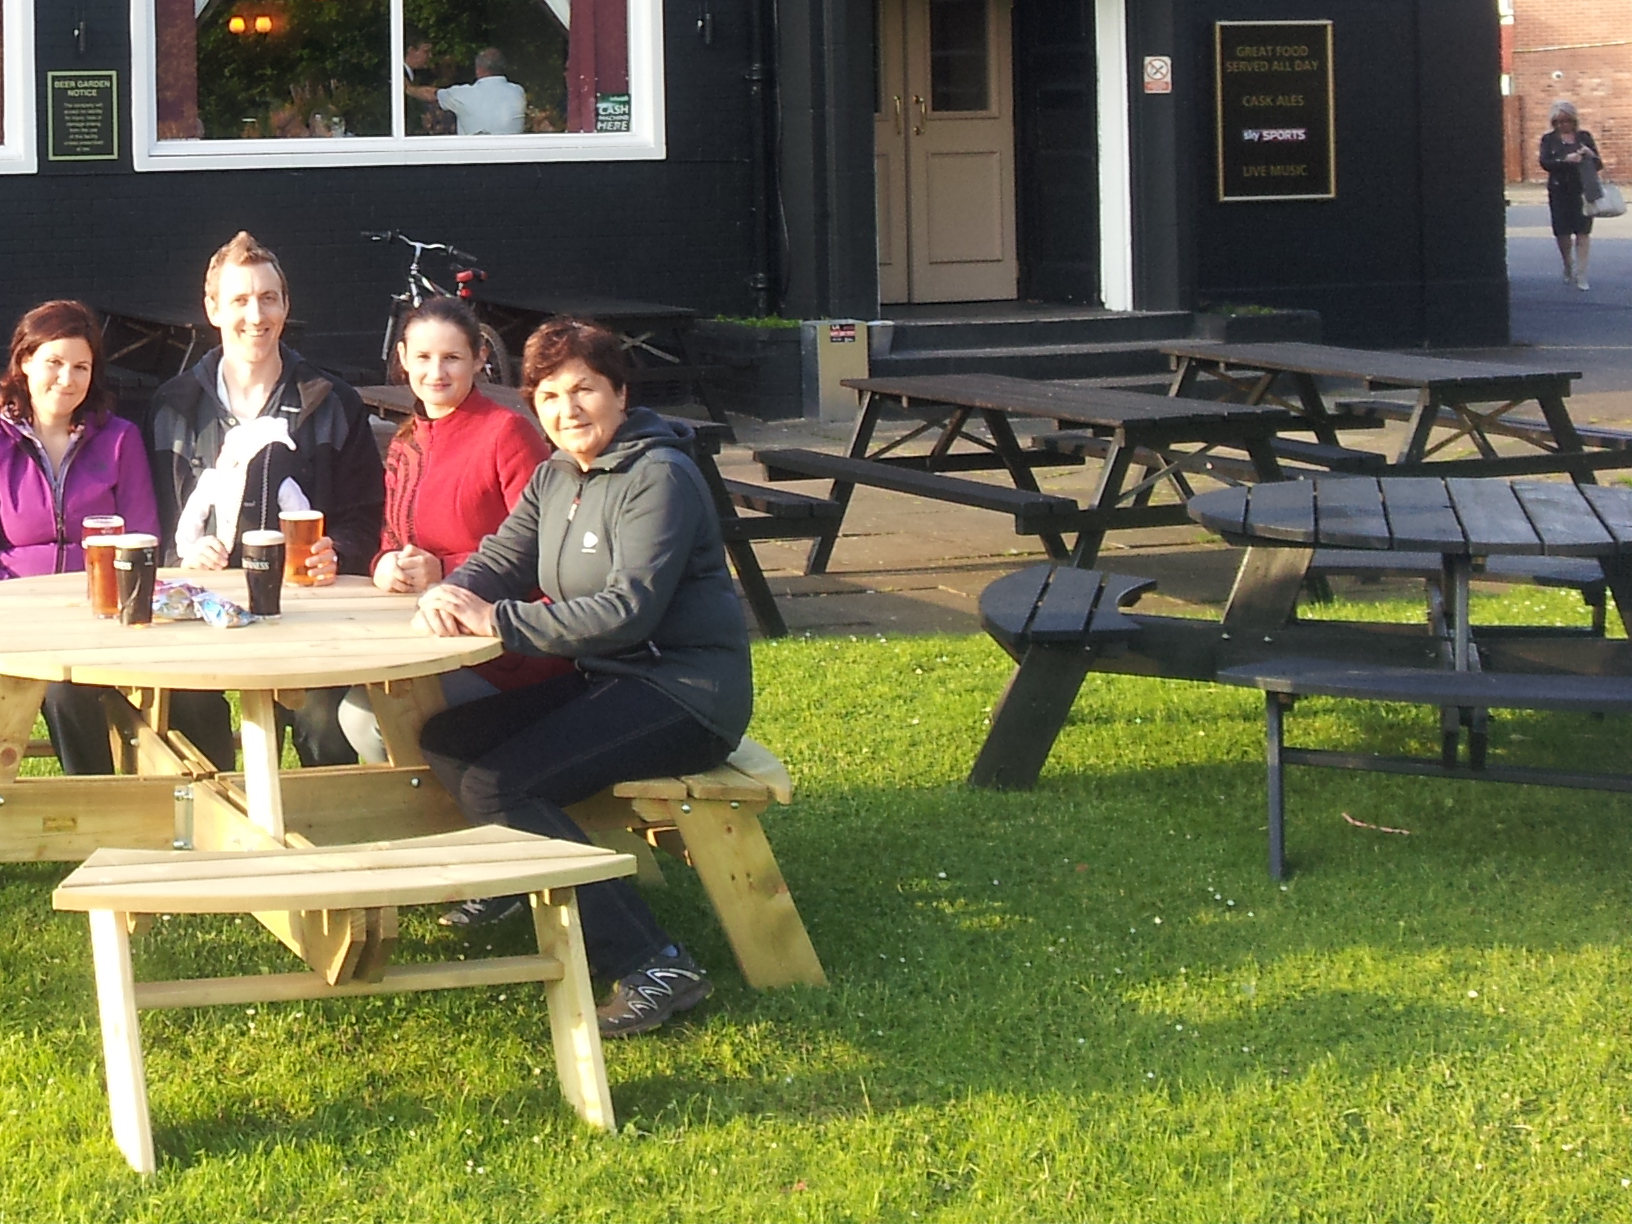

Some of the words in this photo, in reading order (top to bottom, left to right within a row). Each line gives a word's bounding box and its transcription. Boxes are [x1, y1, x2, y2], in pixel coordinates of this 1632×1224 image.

[1236, 46, 1273, 57] GREAT
[1277, 45, 1308, 57] FOOD
[1226, 61, 1268, 73] SERVED
[1272, 61, 1292, 71] ALL
[1294, 60, 1319, 71] DAY
[54, 80, 76, 88] BEER
[77, 80, 110, 88] GARDEN
[1242, 95, 1273, 106] CASK
[1276, 95, 1304, 106] ALES
[598, 104, 629, 115] CASH
[597, 121, 628, 130] HERE
[1243, 131, 1260, 141] sky
[1262, 130, 1306, 140] SPORTS
[1243, 165, 1267, 176] LIVE
[1271, 164, 1308, 175] MUSIC
